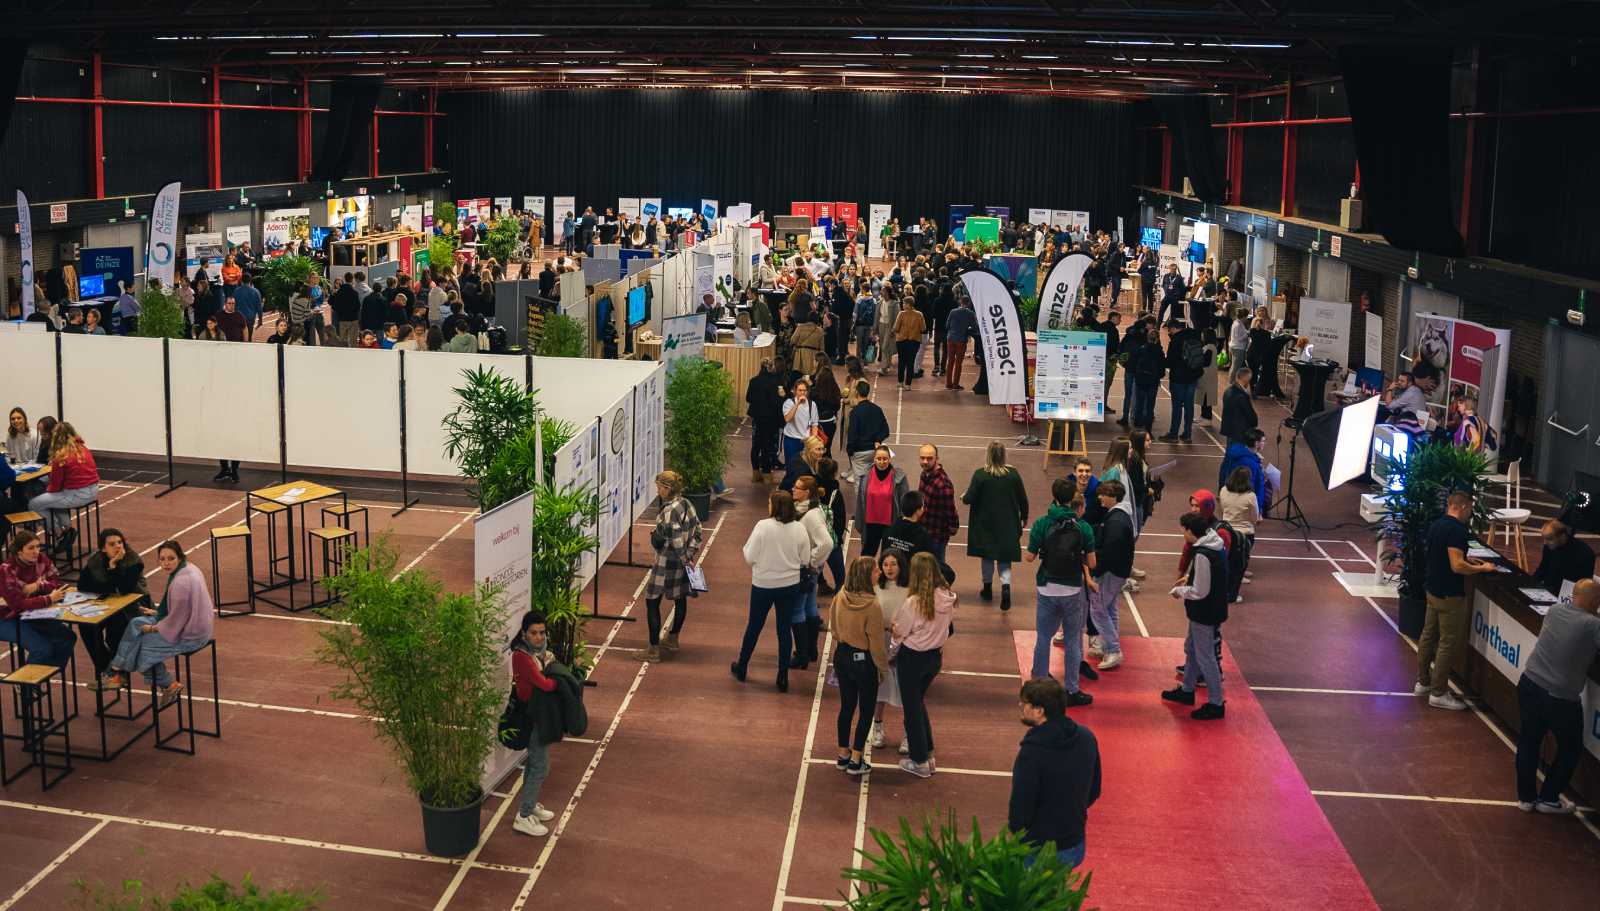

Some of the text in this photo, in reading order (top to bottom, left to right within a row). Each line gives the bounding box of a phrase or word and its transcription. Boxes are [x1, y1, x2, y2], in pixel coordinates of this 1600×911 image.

[266, 222, 288, 232] Adecco
[1048, 282, 1069, 328] einze
[1474, 610, 1521, 668] Onthaal
